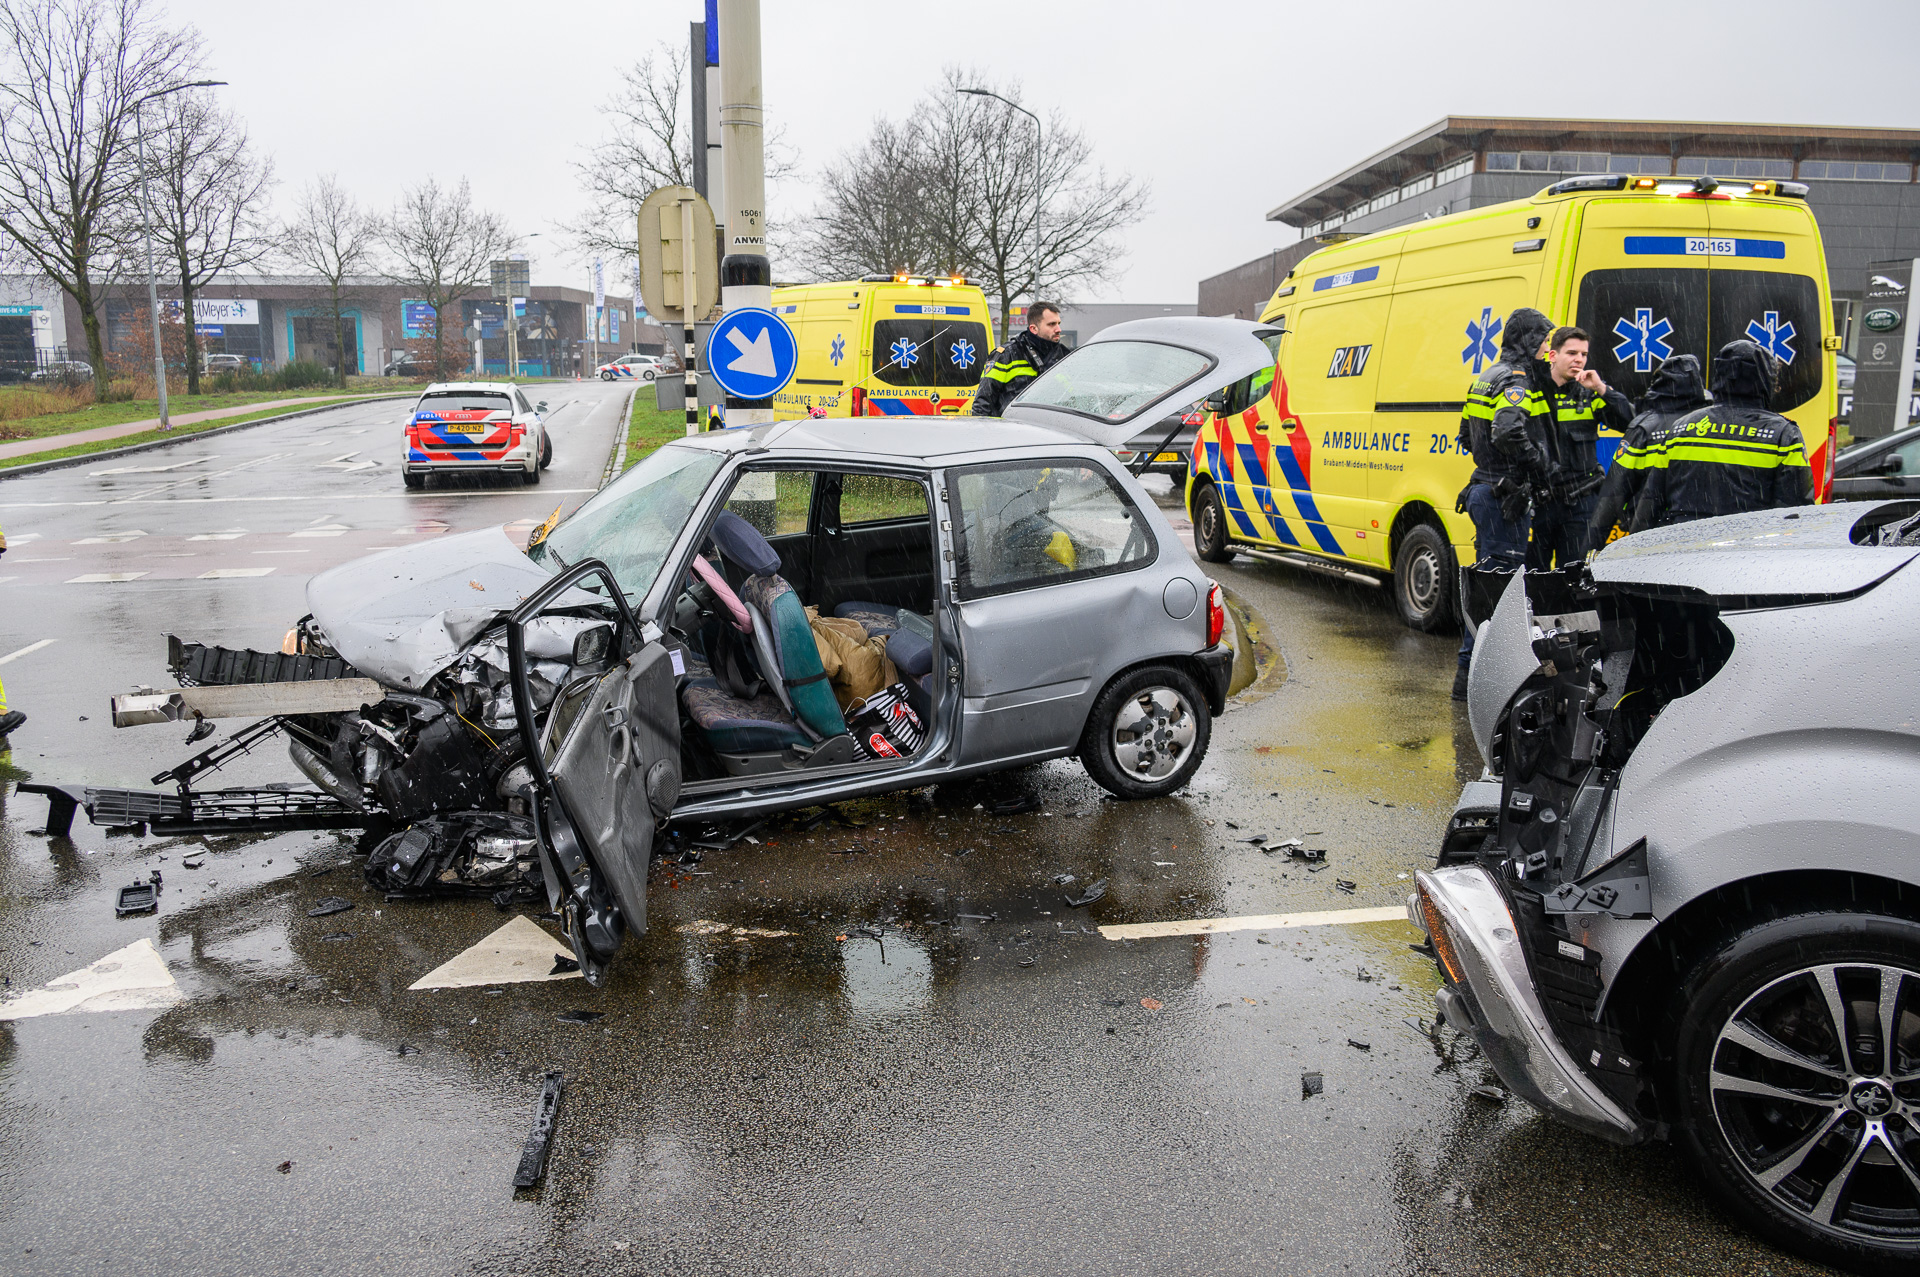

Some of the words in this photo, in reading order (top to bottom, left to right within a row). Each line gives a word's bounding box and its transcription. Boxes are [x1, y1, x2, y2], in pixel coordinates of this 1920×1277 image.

[734, 237, 764, 245] ANWB
[1690, 241, 1731, 252] 20-165
[1328, 345, 1372, 377] RAV
[869, 389, 929, 397] AMBULANCE
[956, 389, 978, 397] 20-22
[773, 393, 811, 406] AMBULANCE
[818, 396, 839, 408] 20-225
[1686, 415, 1758, 437] POLITIE
[1322, 431, 1410, 452] AMBULANCE
[1323, 458, 1404, 472] Brabant-Midden-West-Noord
